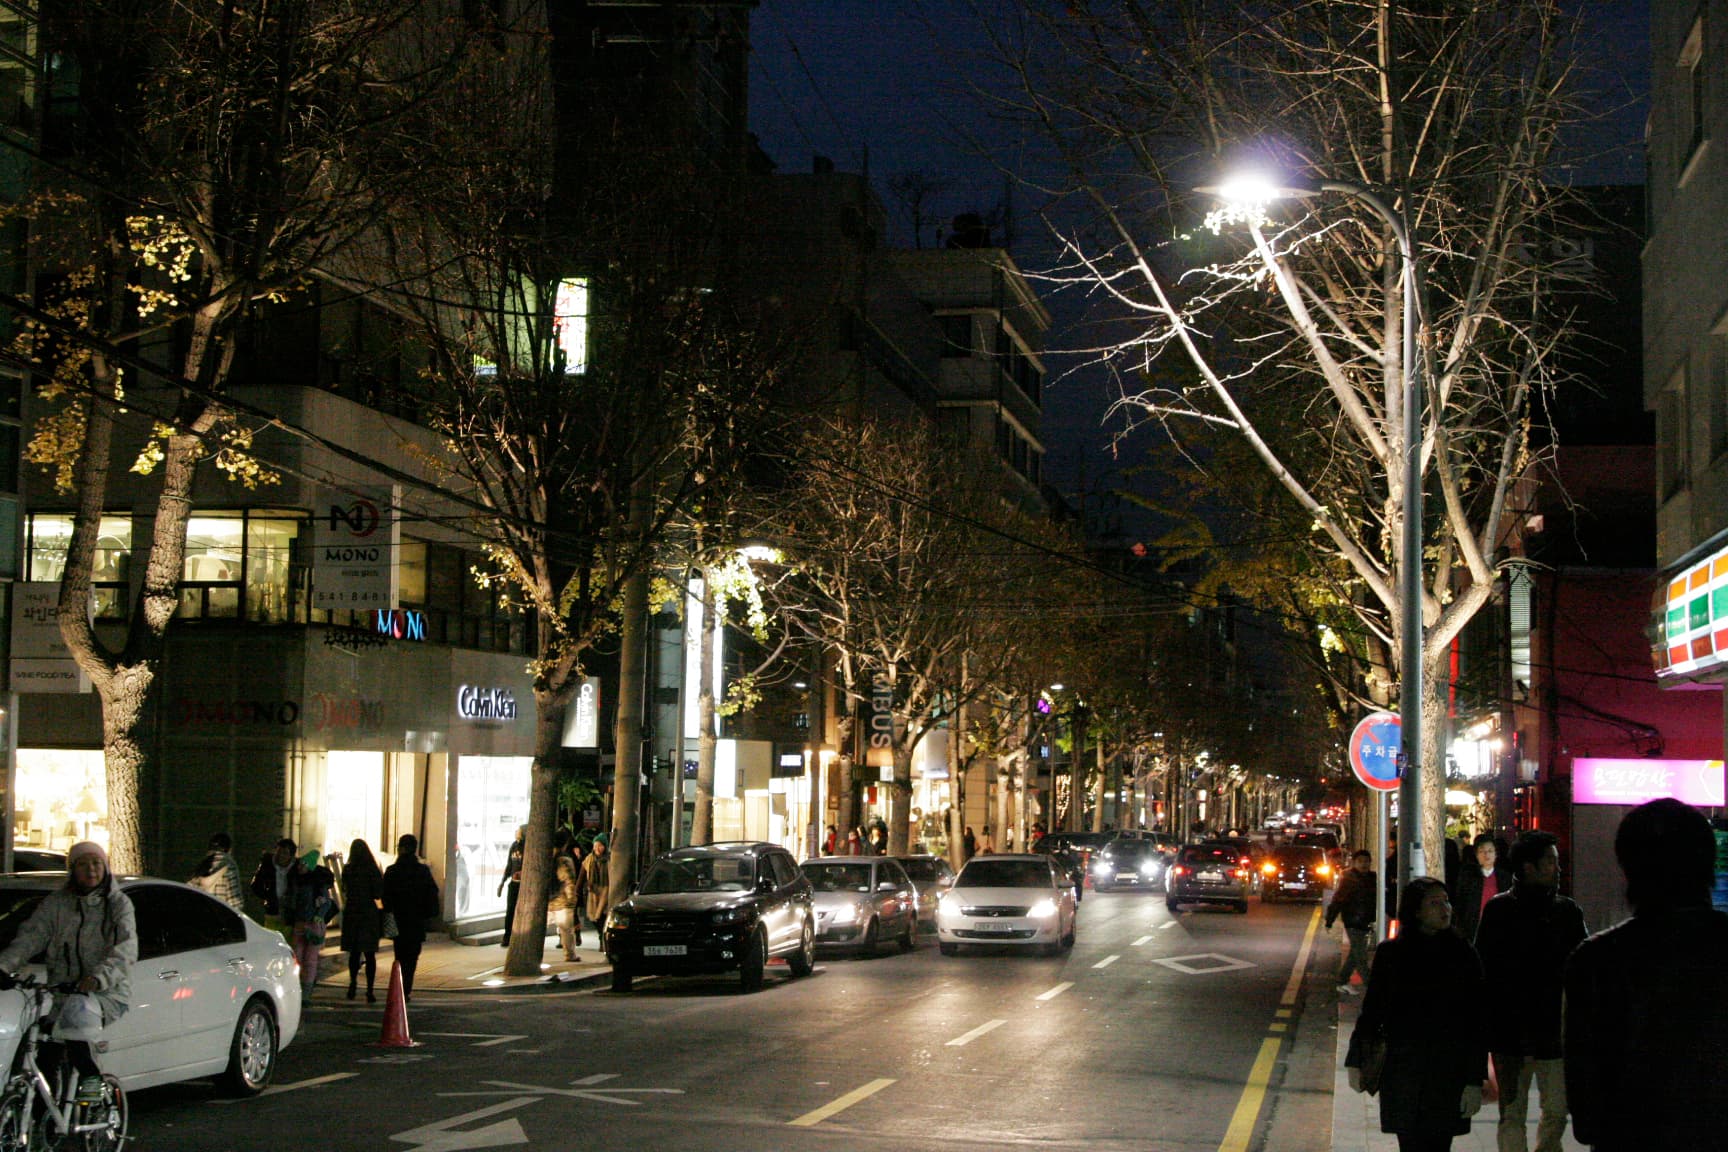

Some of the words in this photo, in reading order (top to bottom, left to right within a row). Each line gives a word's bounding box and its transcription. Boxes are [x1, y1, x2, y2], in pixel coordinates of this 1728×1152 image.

[326, 549, 379, 562] MONO
[377, 608, 429, 641] MONO
[459, 686, 492, 718] Calvin
[494, 689, 517, 719] Klein
[1361, 744, 1399, 758] 주차금
